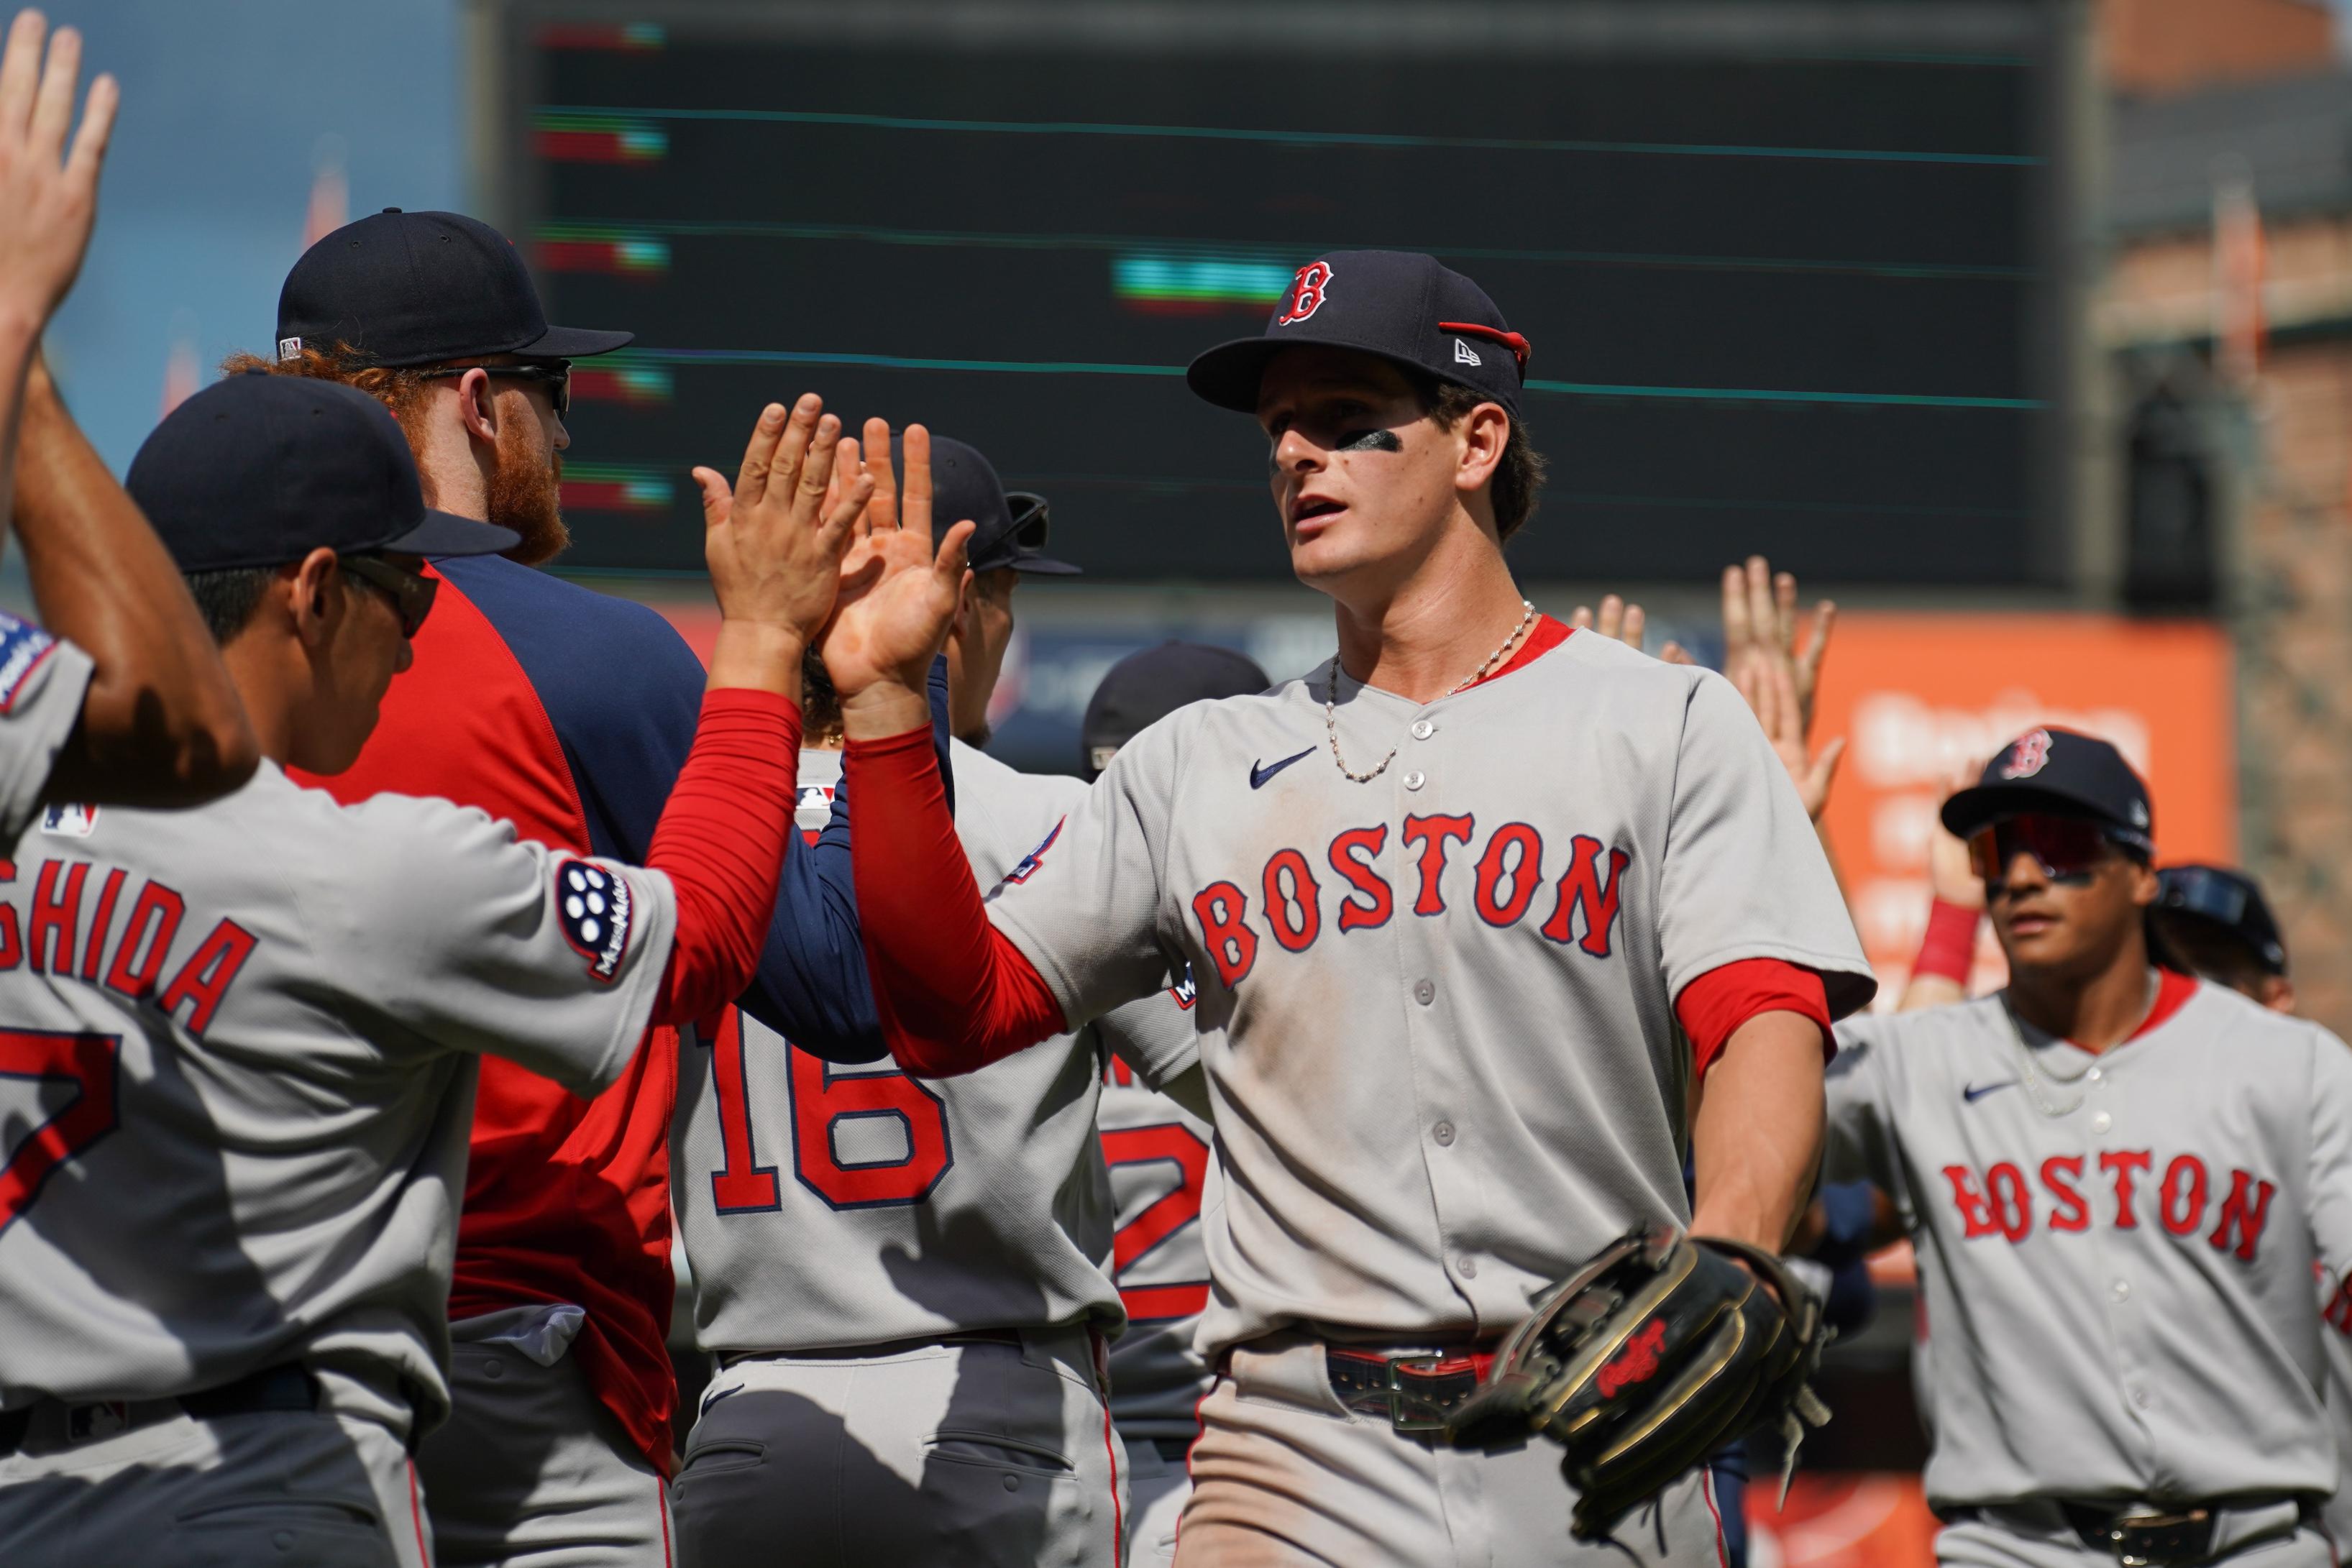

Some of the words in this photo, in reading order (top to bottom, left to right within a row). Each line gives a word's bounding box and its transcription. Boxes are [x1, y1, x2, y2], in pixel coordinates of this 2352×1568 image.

[1278, 260, 1334, 326] B
[1192, 812, 1630, 991] BOSTON
[694, 1001, 955, 1216] 16
[1941, 1150, 2275, 1262] BOSTON
